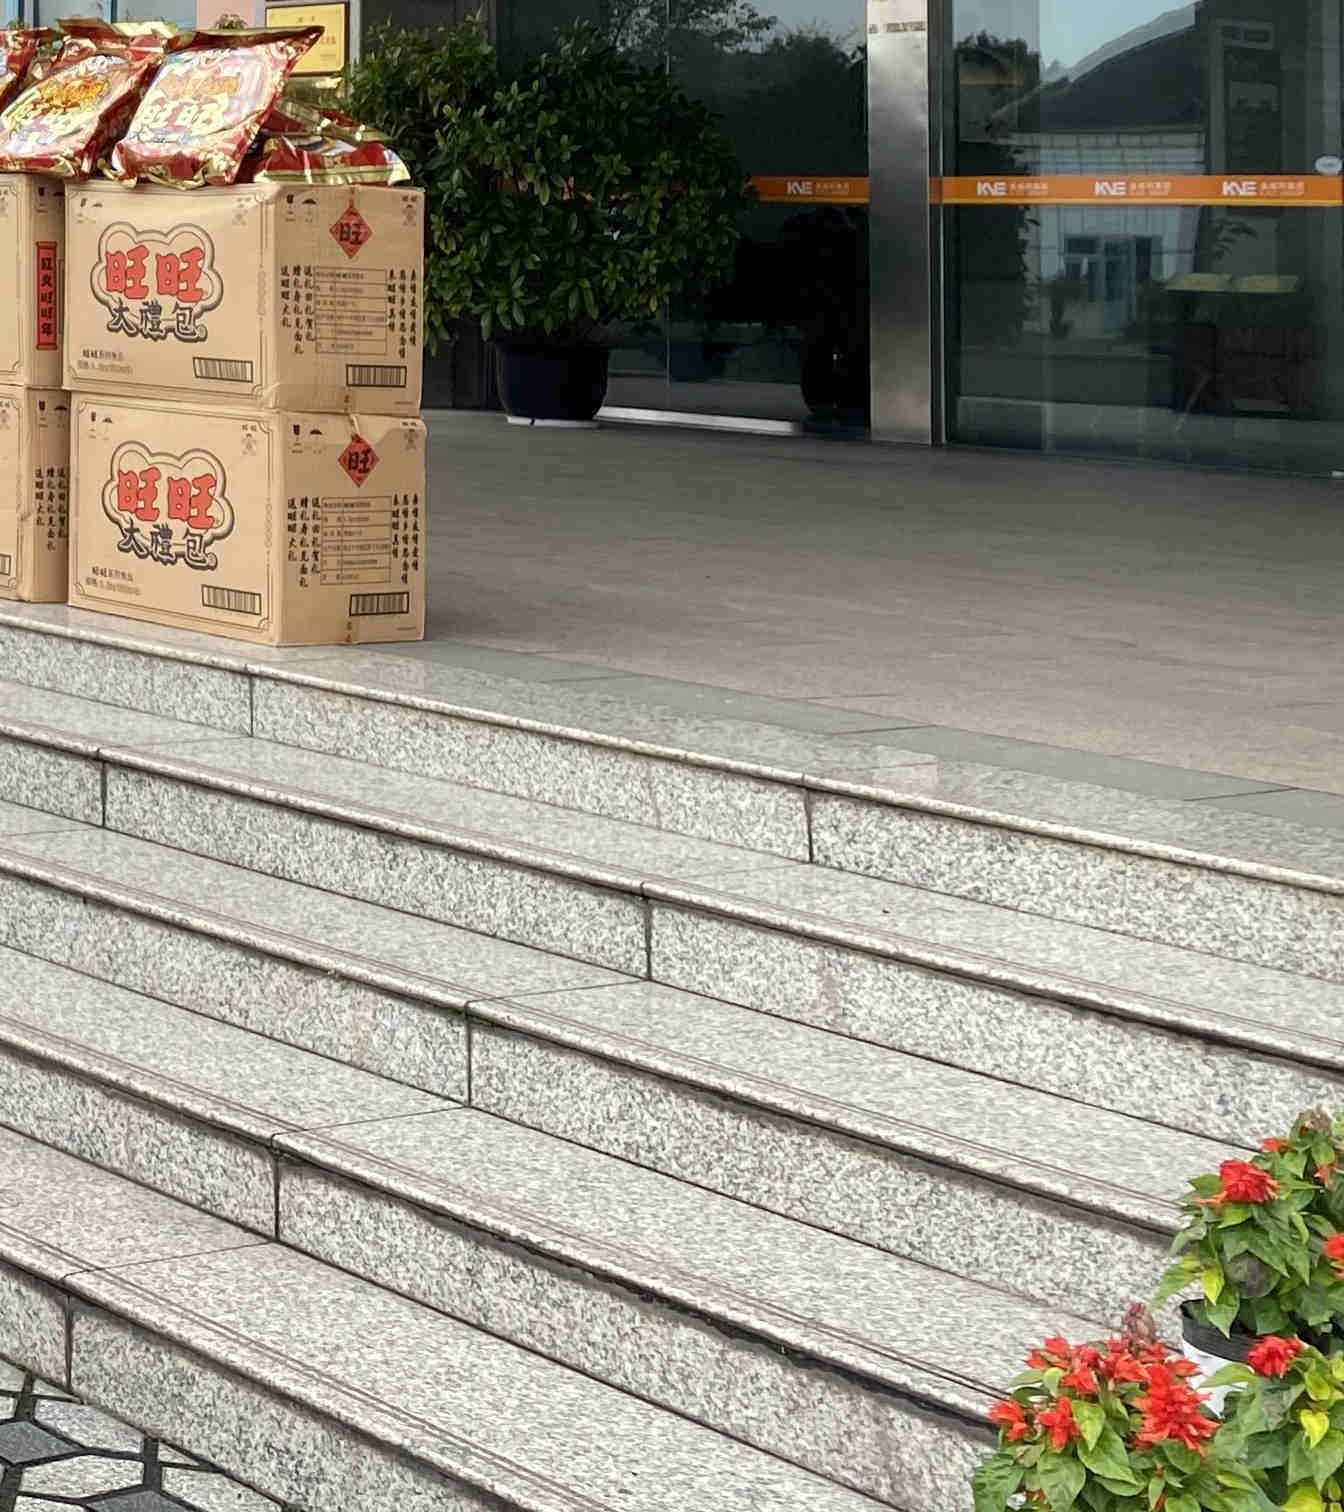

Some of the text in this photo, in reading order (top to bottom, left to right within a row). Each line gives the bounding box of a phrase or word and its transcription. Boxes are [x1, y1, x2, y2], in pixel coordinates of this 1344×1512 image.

[105, 245, 205, 303] 旺旺
[347, 451, 371, 474] 旺
[117, 466, 217, 530] 旺旺
